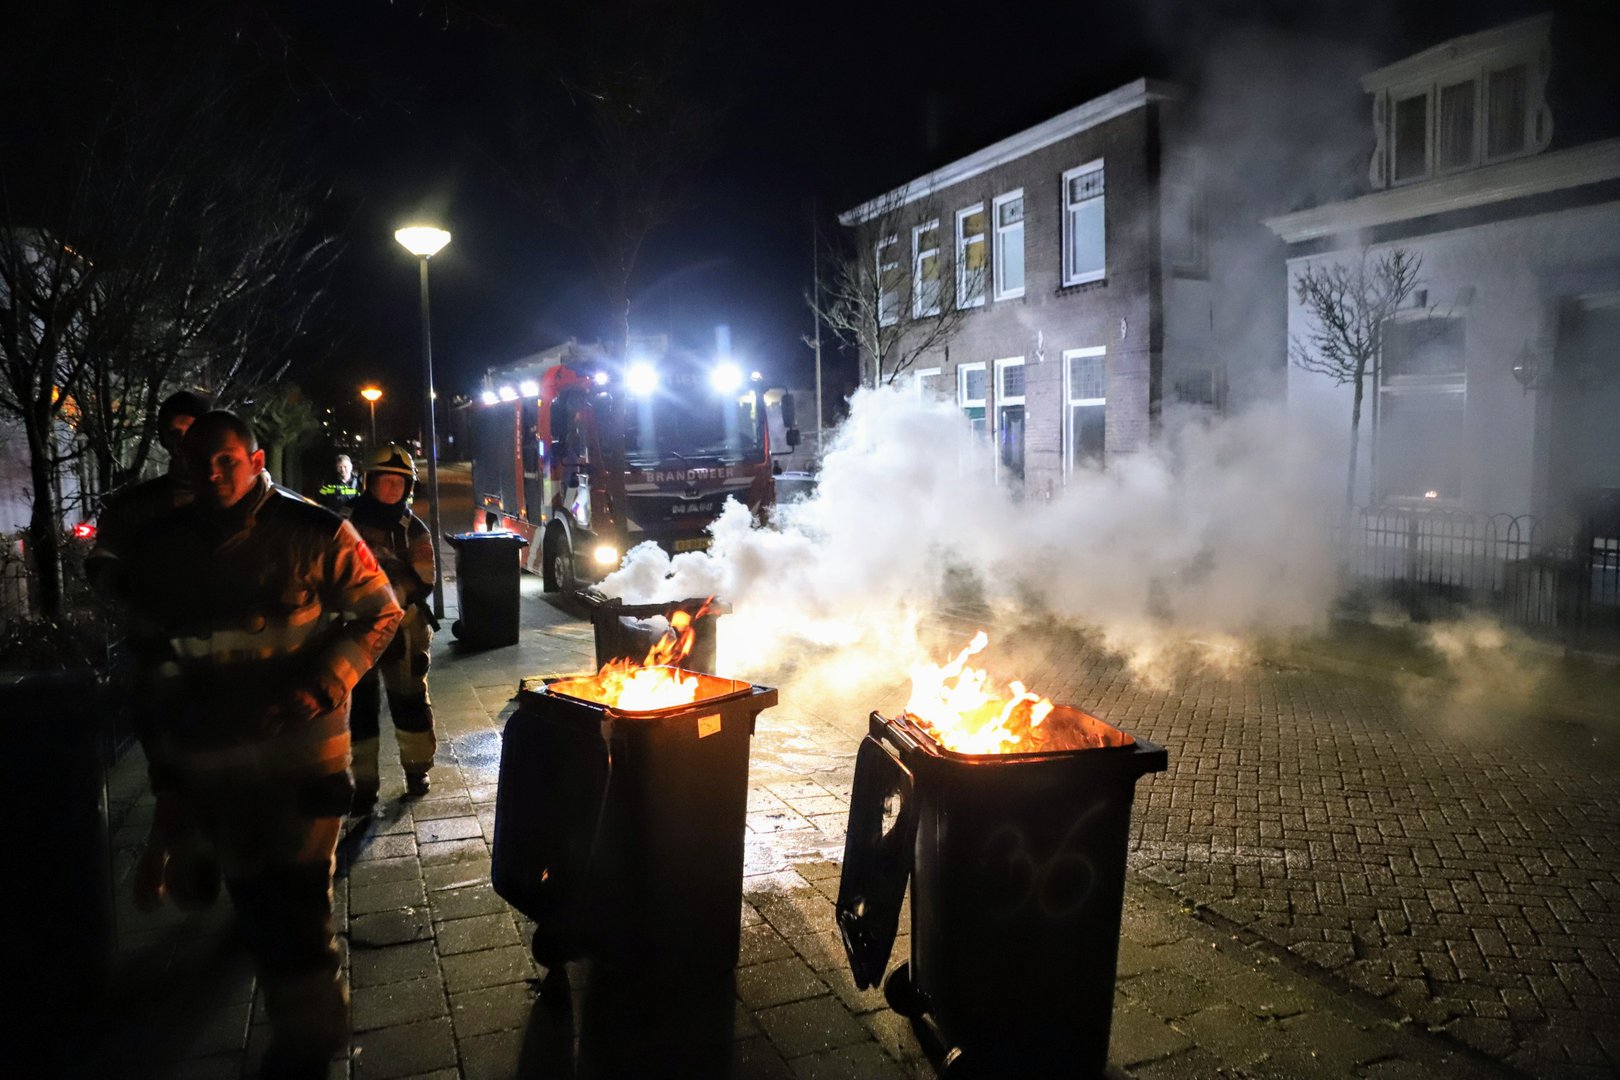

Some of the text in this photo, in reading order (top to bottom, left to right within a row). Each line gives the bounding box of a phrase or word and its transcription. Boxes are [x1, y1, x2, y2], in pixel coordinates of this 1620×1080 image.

[647, 467, 734, 482] BRANDWEER
[672, 502, 713, 514] MAN
[982, 799, 1105, 919] 36
